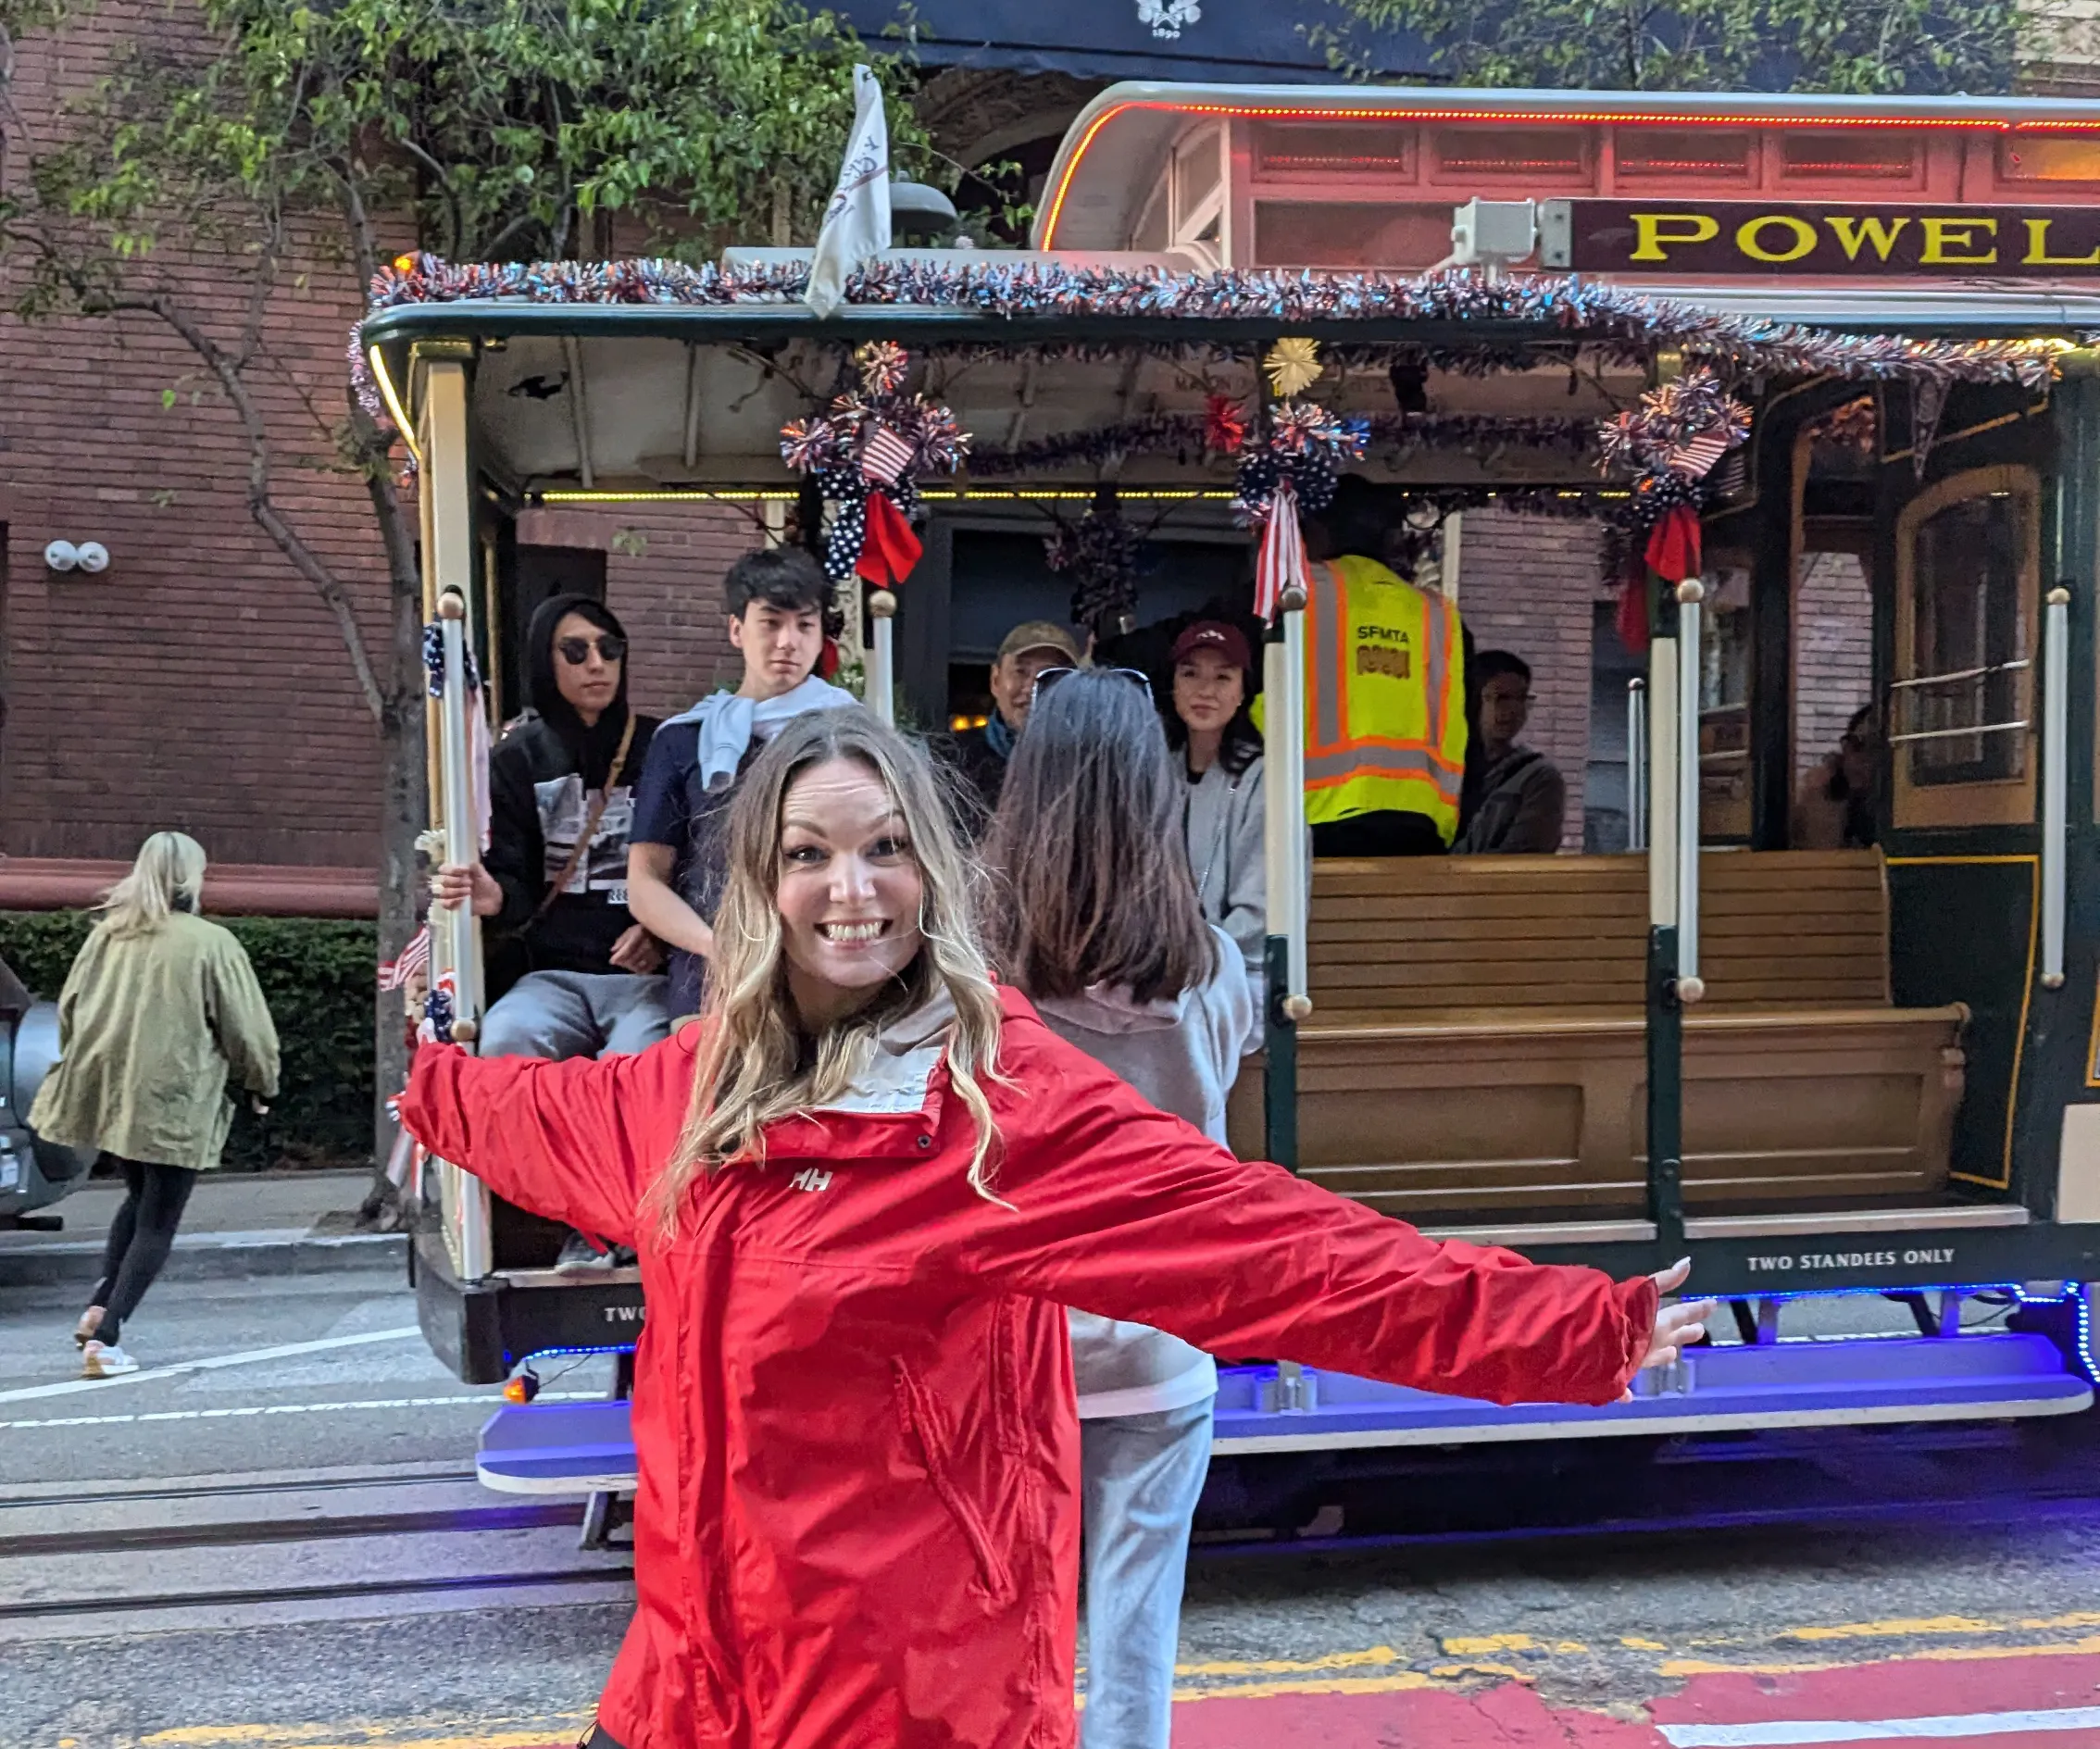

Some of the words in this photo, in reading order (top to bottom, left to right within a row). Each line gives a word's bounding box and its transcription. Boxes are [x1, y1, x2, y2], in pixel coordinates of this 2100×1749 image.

[1629, 213, 2100, 266] POWEL
[1356, 625, 1409, 643] SFMTA
[789, 1167, 833, 1192] HH
[1747, 1256, 1794, 1271] TWO
[1799, 1251, 1897, 1269] STANDEES
[1903, 1248, 1956, 1264] ONLY
